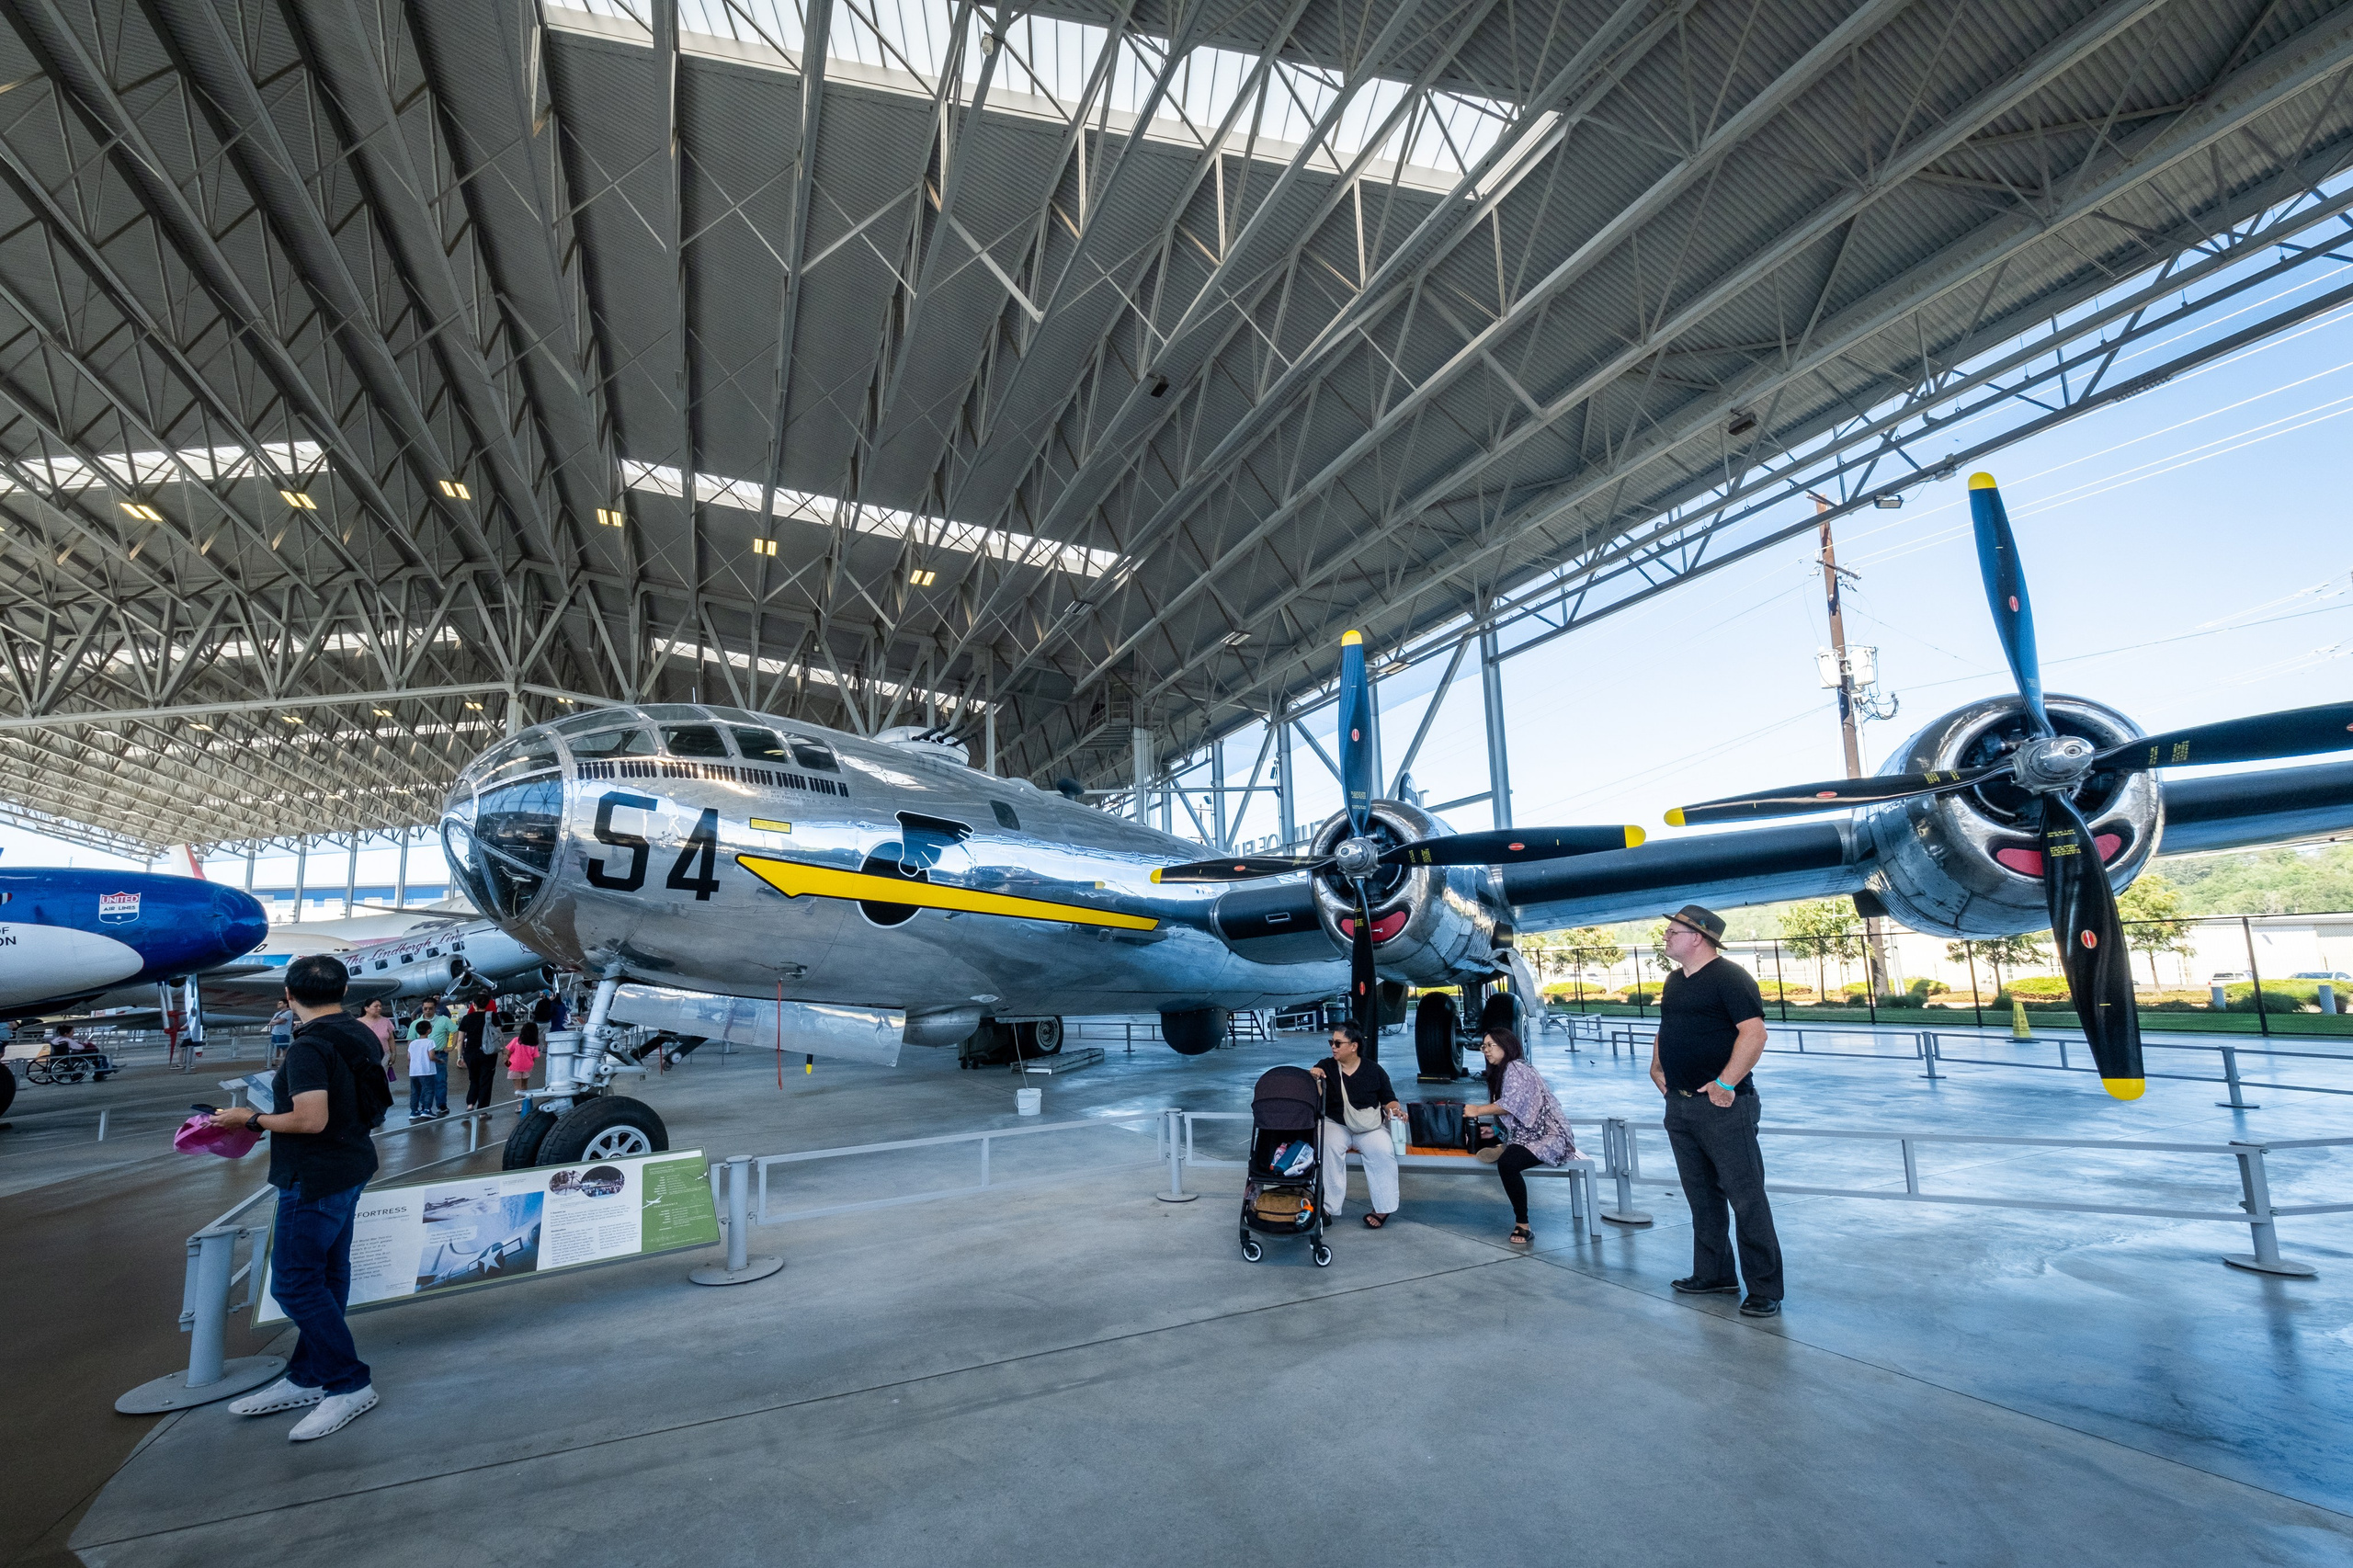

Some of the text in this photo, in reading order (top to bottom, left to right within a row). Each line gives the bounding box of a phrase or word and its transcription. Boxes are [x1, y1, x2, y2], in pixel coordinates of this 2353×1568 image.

[102, 895, 139, 904] UNITED
[344, 932, 465, 966] The Lindbergh Line
